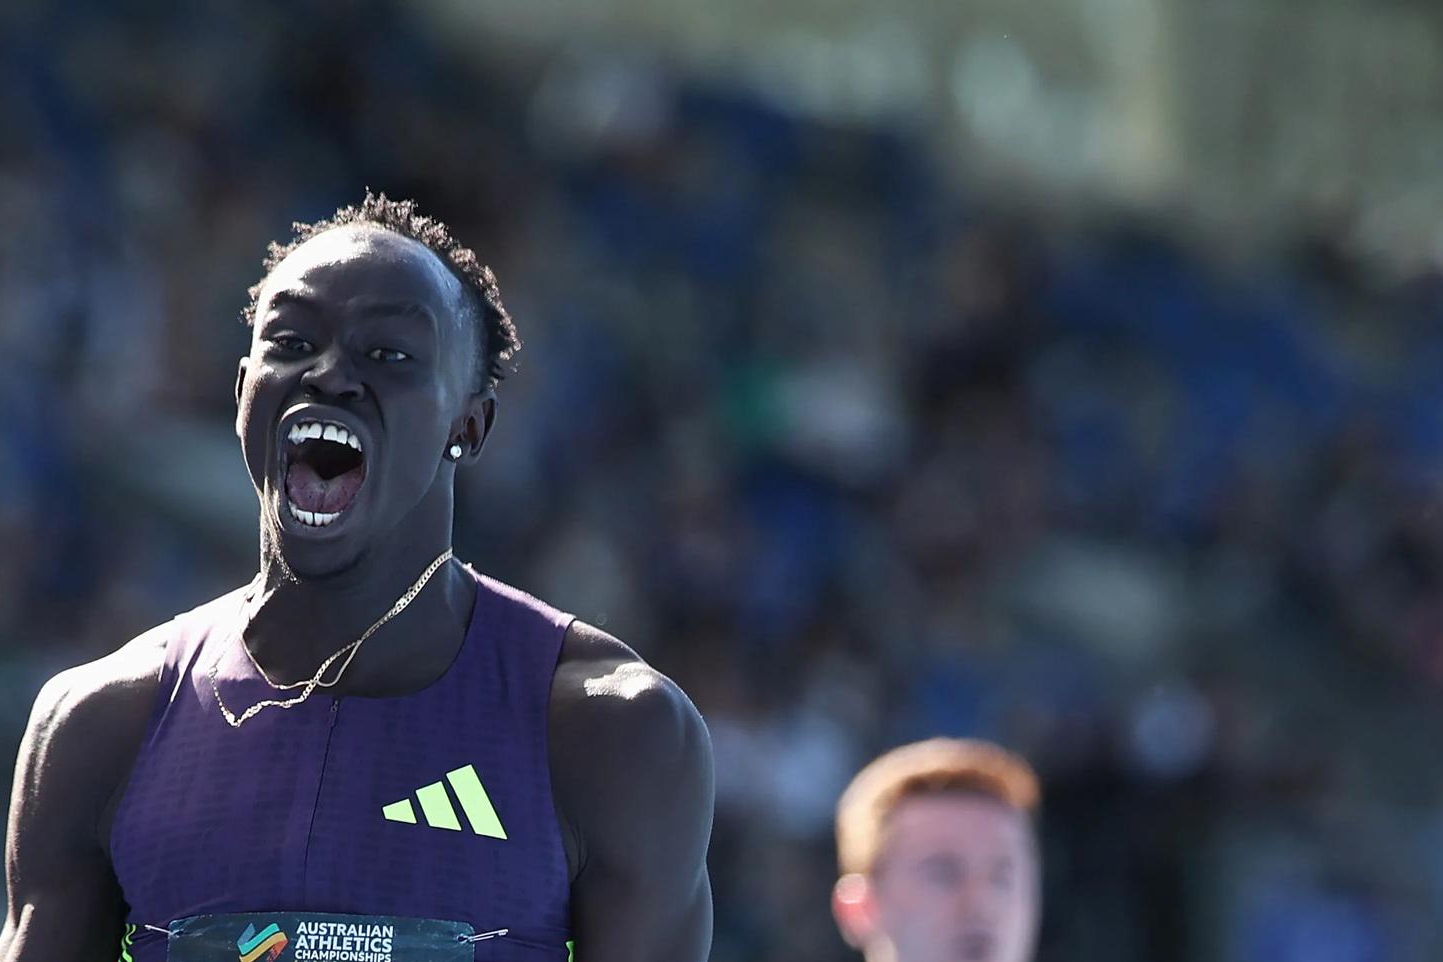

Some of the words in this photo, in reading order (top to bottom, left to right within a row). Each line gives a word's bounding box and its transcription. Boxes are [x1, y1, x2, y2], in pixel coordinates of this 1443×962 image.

[296, 922, 393, 937] AUSTRALIAN
[295, 935, 392, 953] ATHLETICS
[295, 950, 391, 962] CHAMPIONSHIPS
